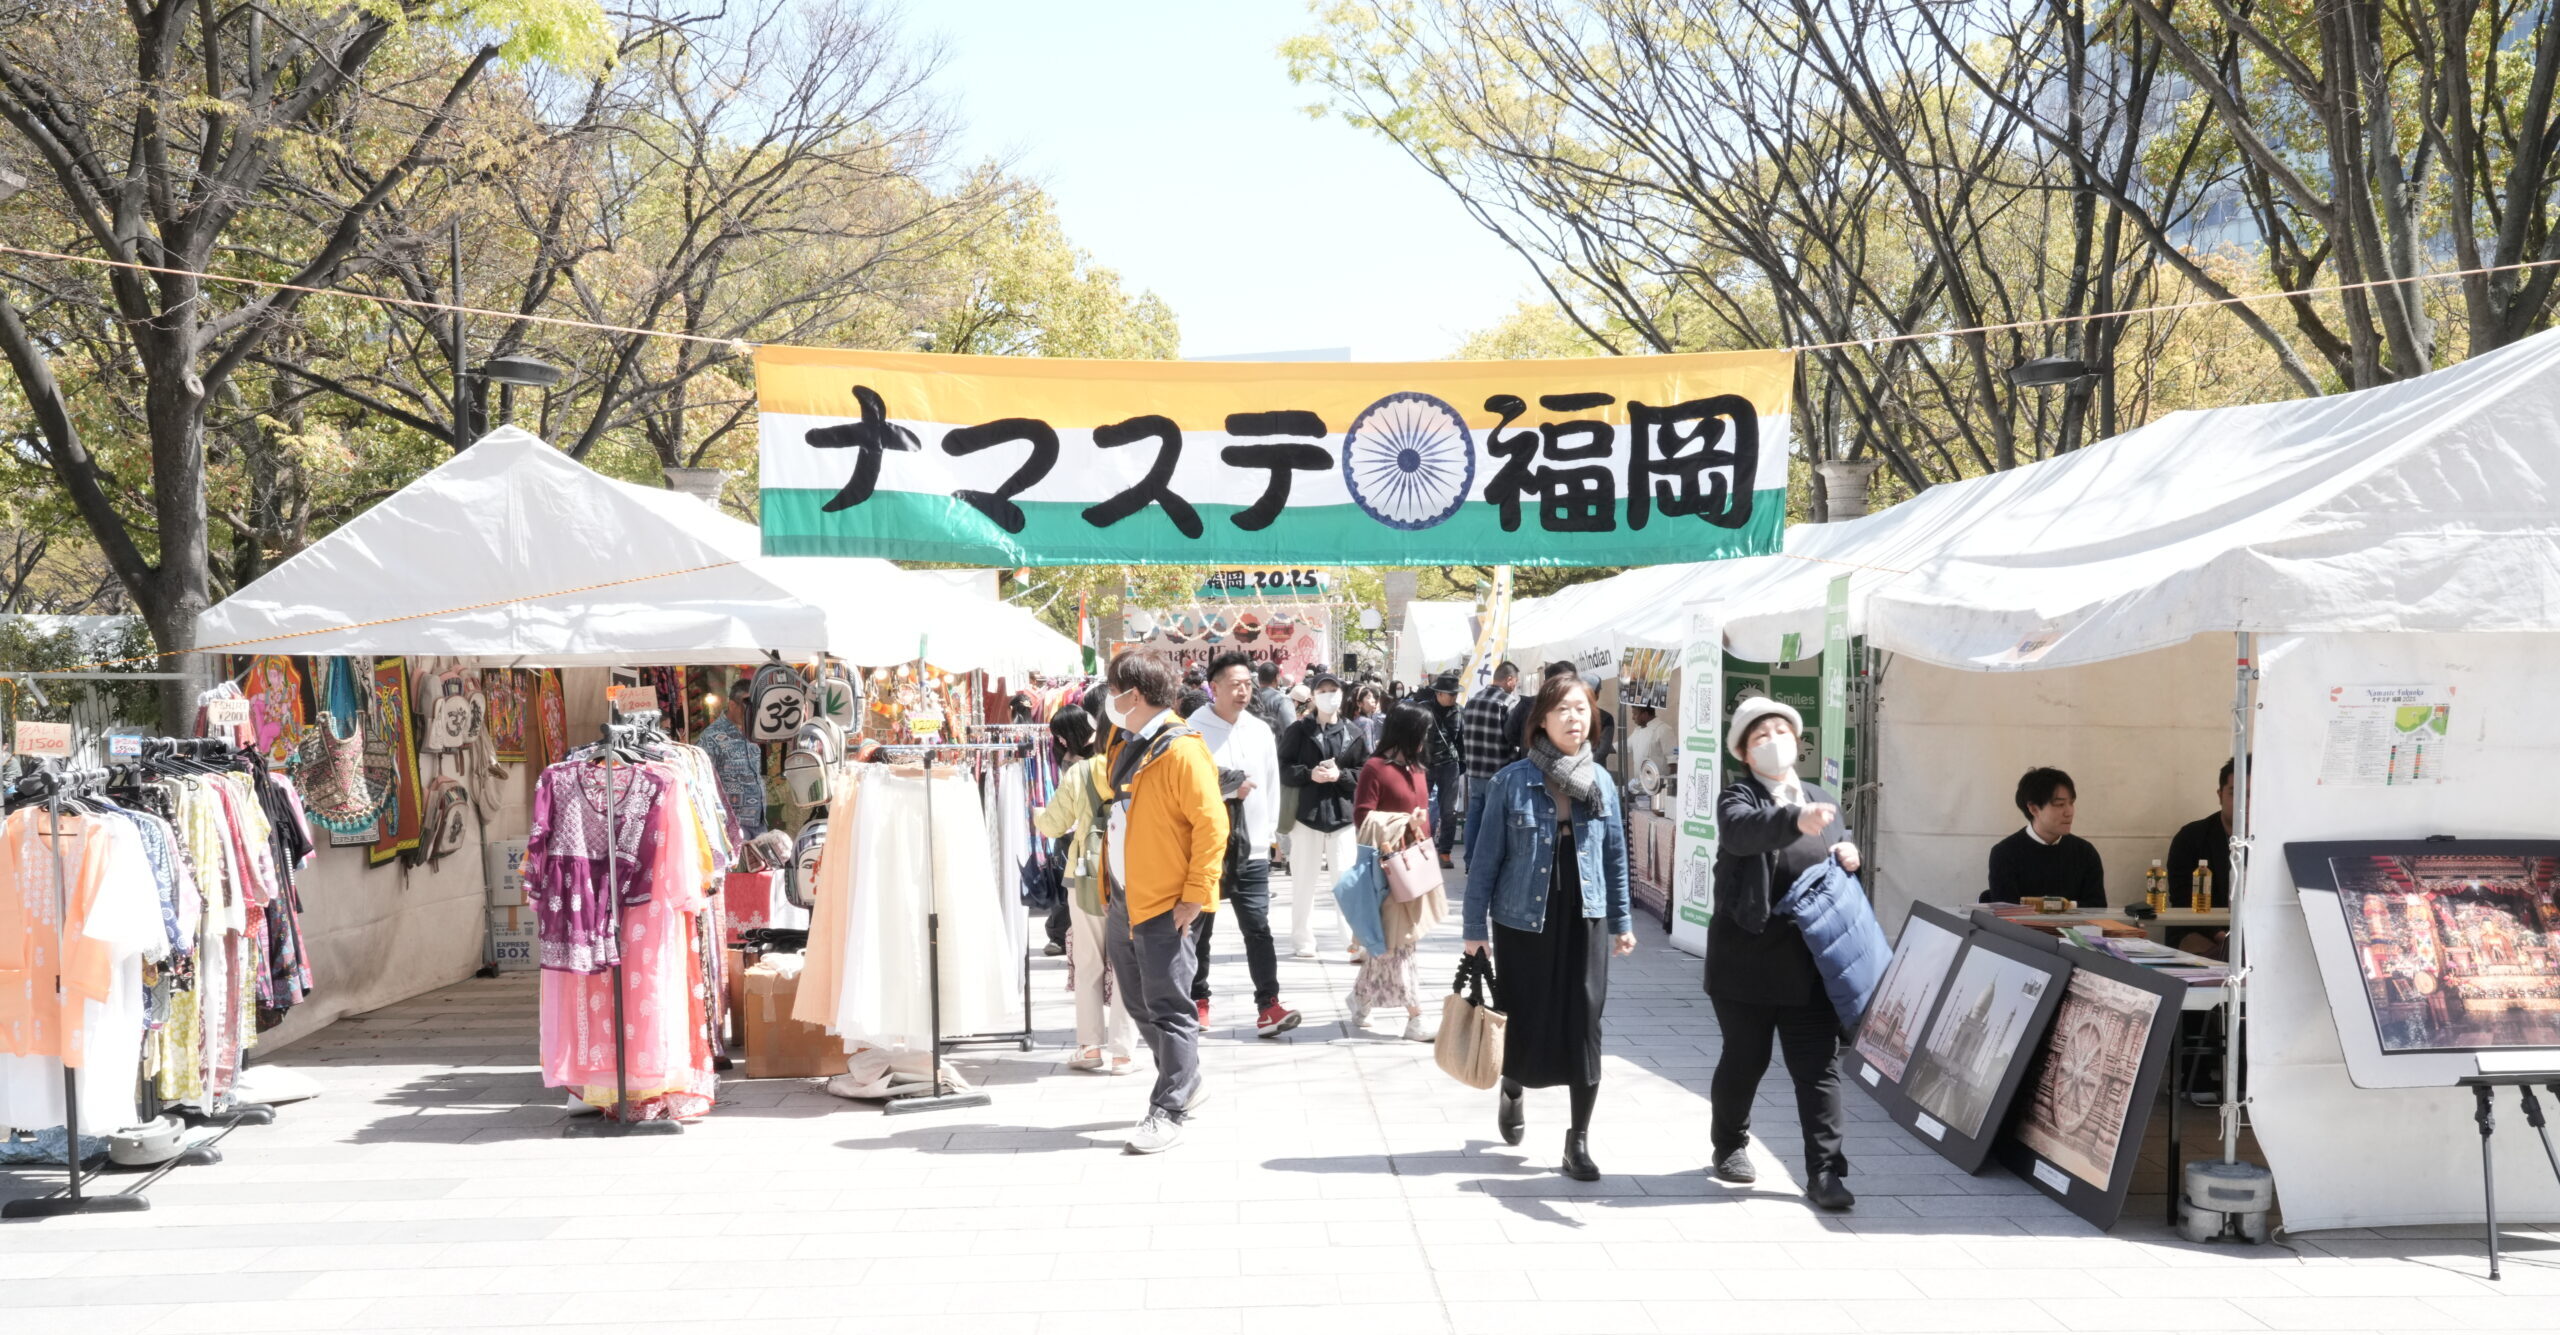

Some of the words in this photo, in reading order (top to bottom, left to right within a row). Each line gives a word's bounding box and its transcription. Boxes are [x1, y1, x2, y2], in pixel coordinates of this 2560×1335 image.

[806, 385, 1334, 539] ナマステ
[1485, 391, 1760, 533] 福岡
[1251, 568, 1319, 589] 2025
[1584, 645, 1612, 671] Indian
[1775, 692, 1816, 706] Smiles
[496, 948, 530, 958] BOX
